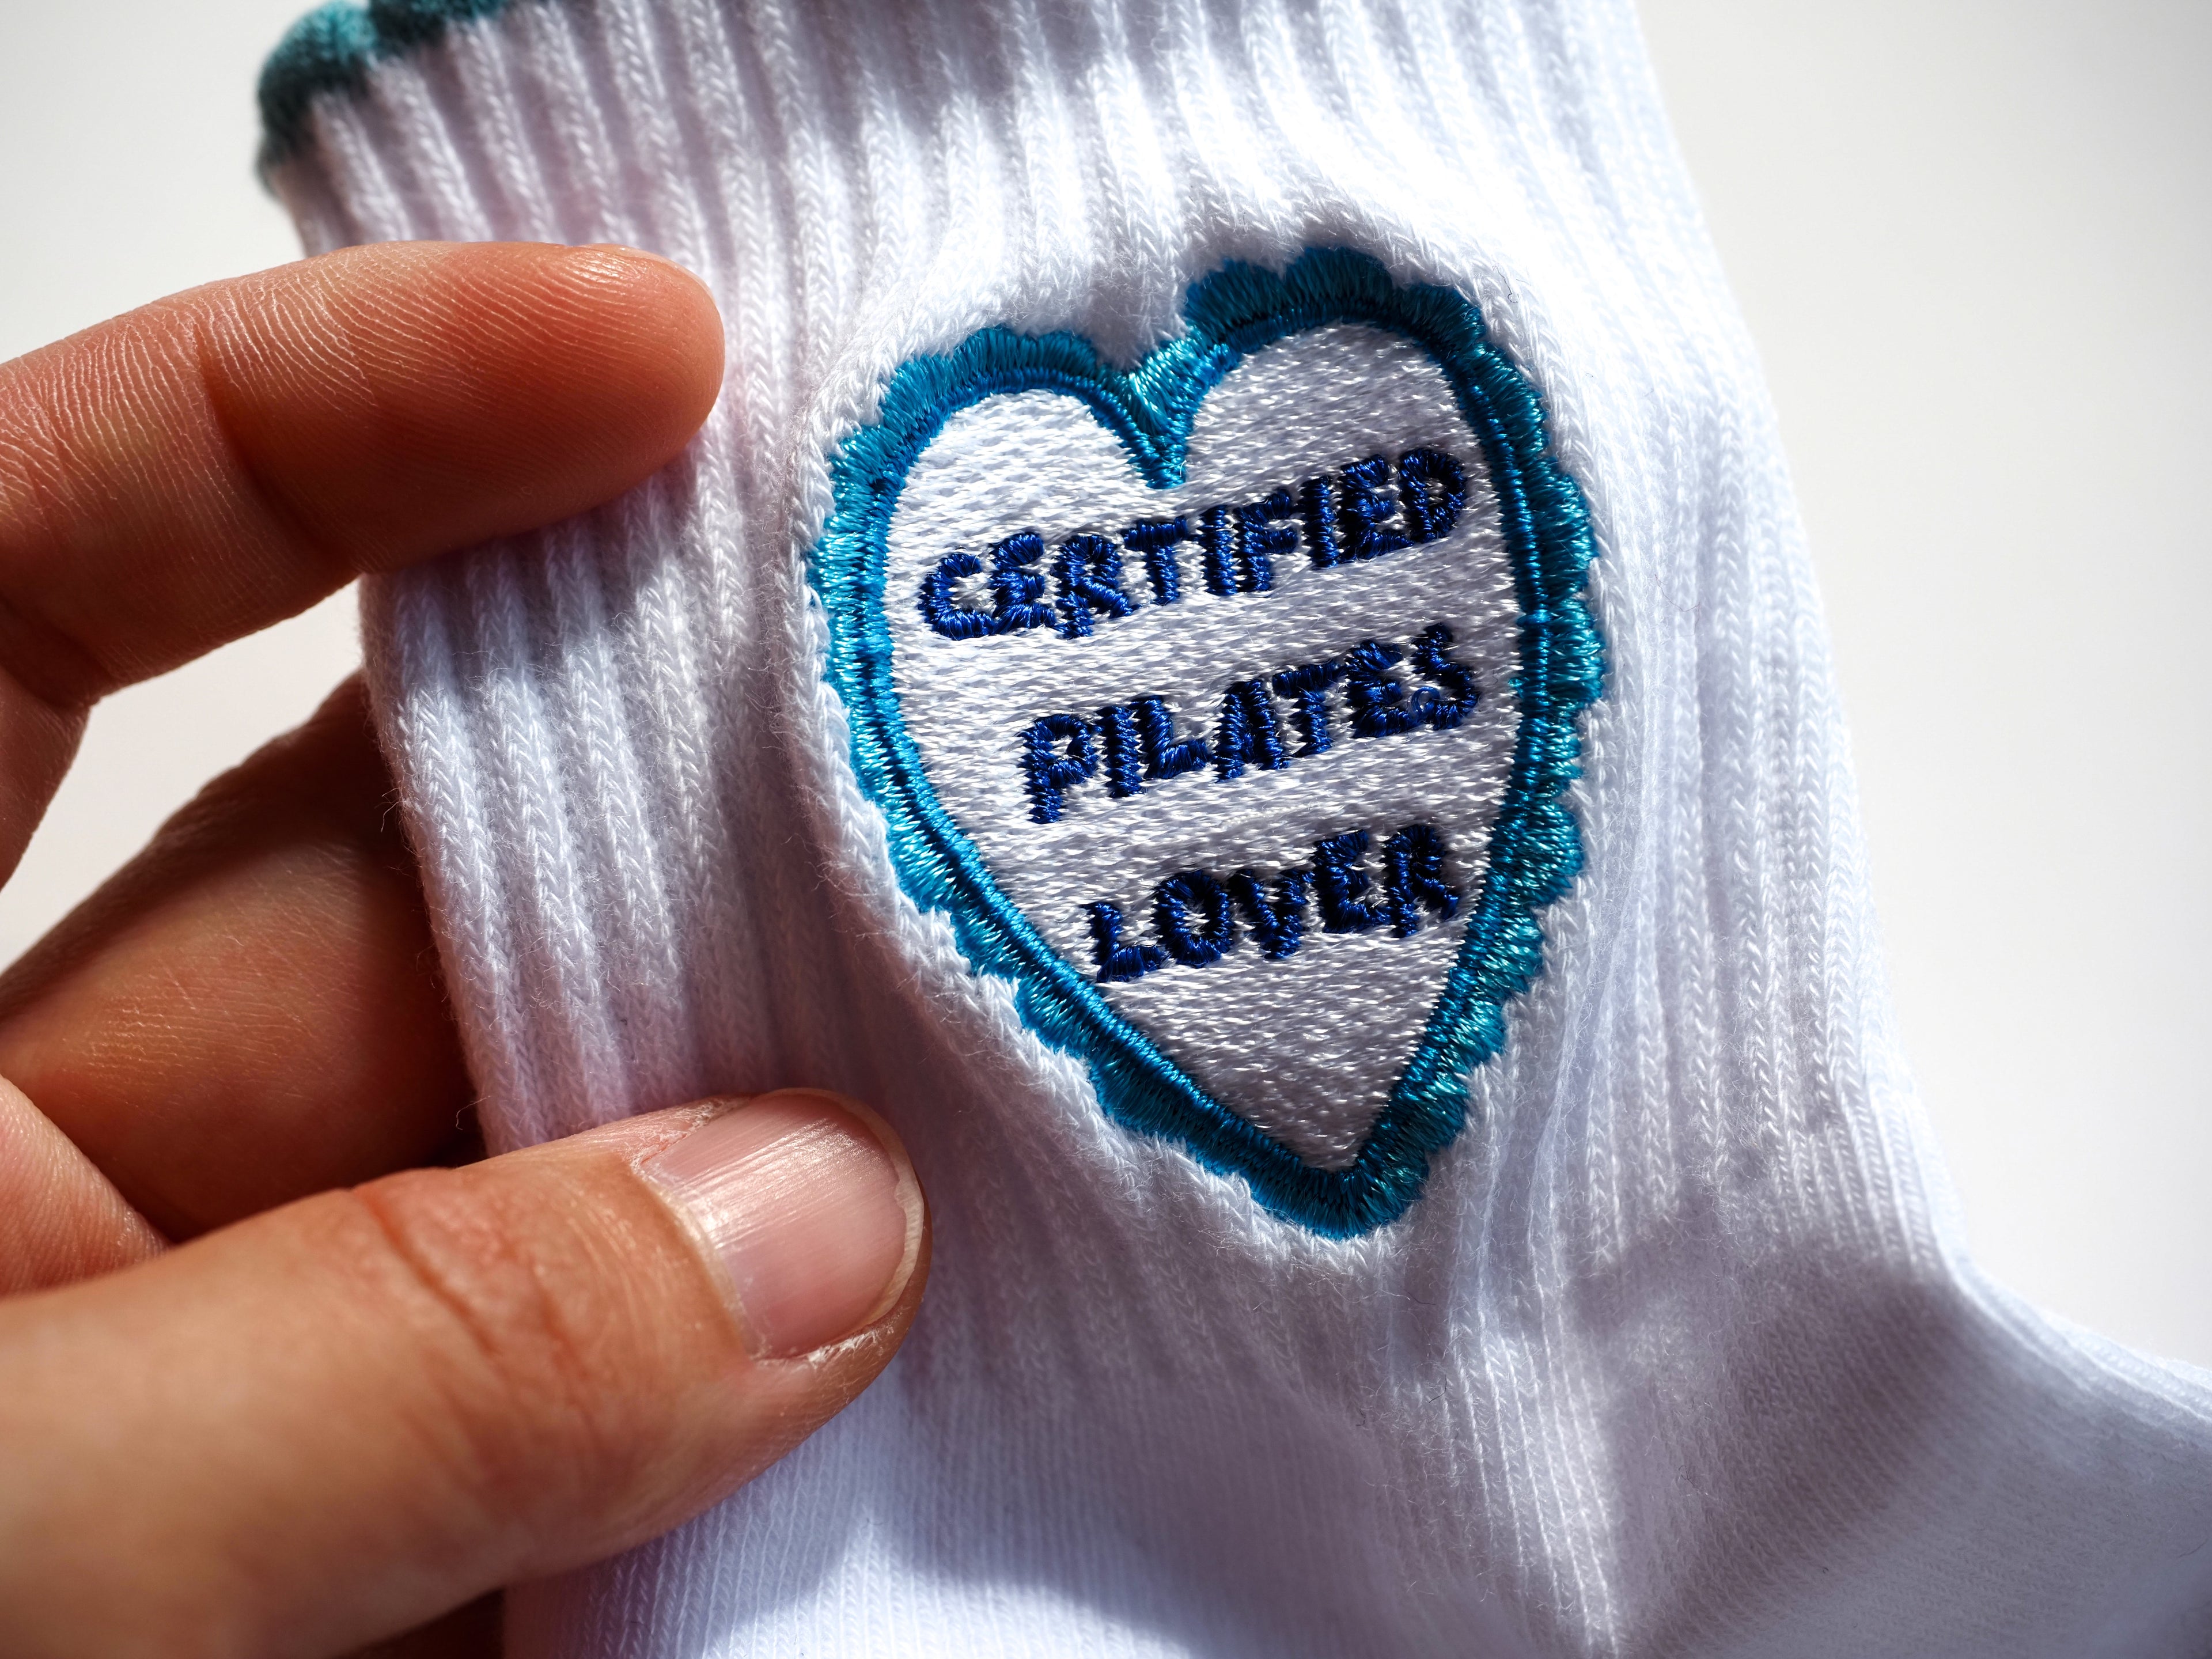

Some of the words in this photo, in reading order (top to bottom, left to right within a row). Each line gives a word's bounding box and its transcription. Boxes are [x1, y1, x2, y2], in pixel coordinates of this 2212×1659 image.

[919, 448, 1467, 641] CERTIFIED
[1016, 622, 1479, 824] PILATES
[1084, 824, 1460, 983] LOVER
